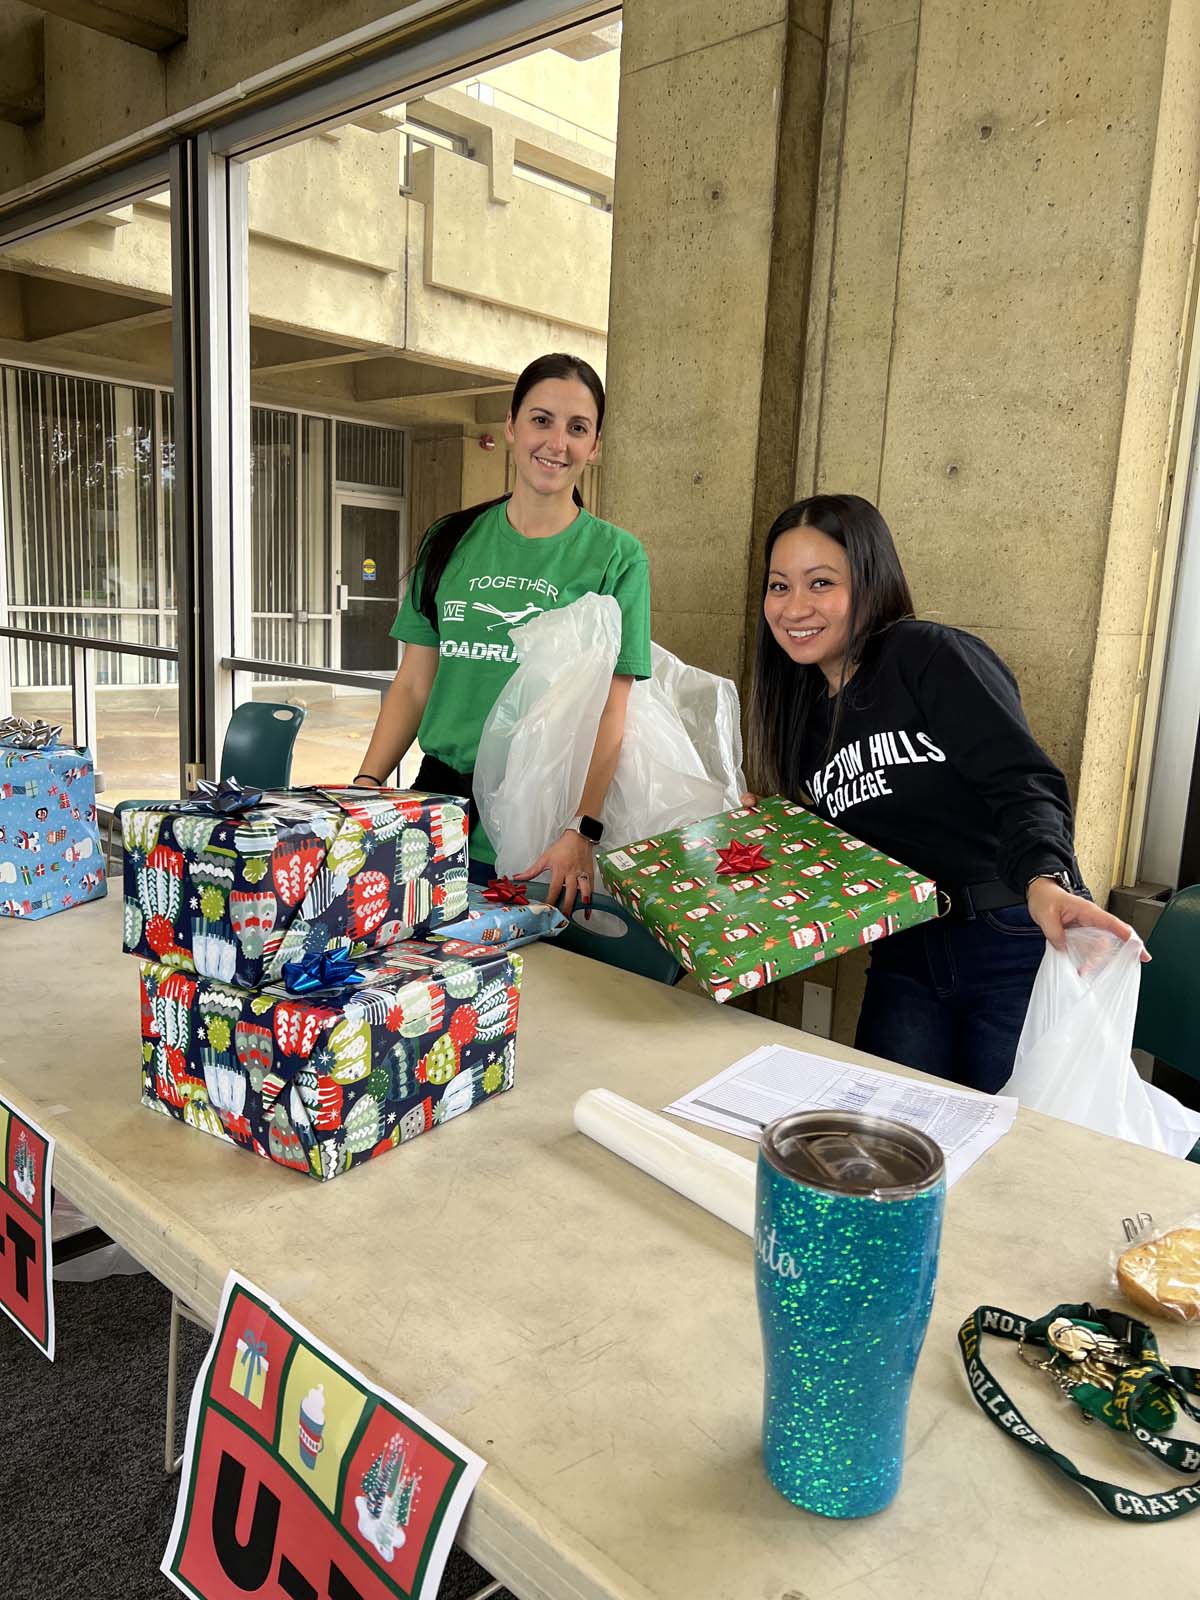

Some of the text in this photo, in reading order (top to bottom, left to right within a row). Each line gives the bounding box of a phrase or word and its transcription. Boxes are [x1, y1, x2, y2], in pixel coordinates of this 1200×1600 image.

[468, 575, 560, 603] TOGETHER
[443, 603, 466, 618] WE
[440, 640, 520, 663] OADRU
[805, 730, 946, 807] AFTON HILLS
[826, 769, 893, 818] COLLEGE
[969, 1359, 1046, 1446] COLLEGE
